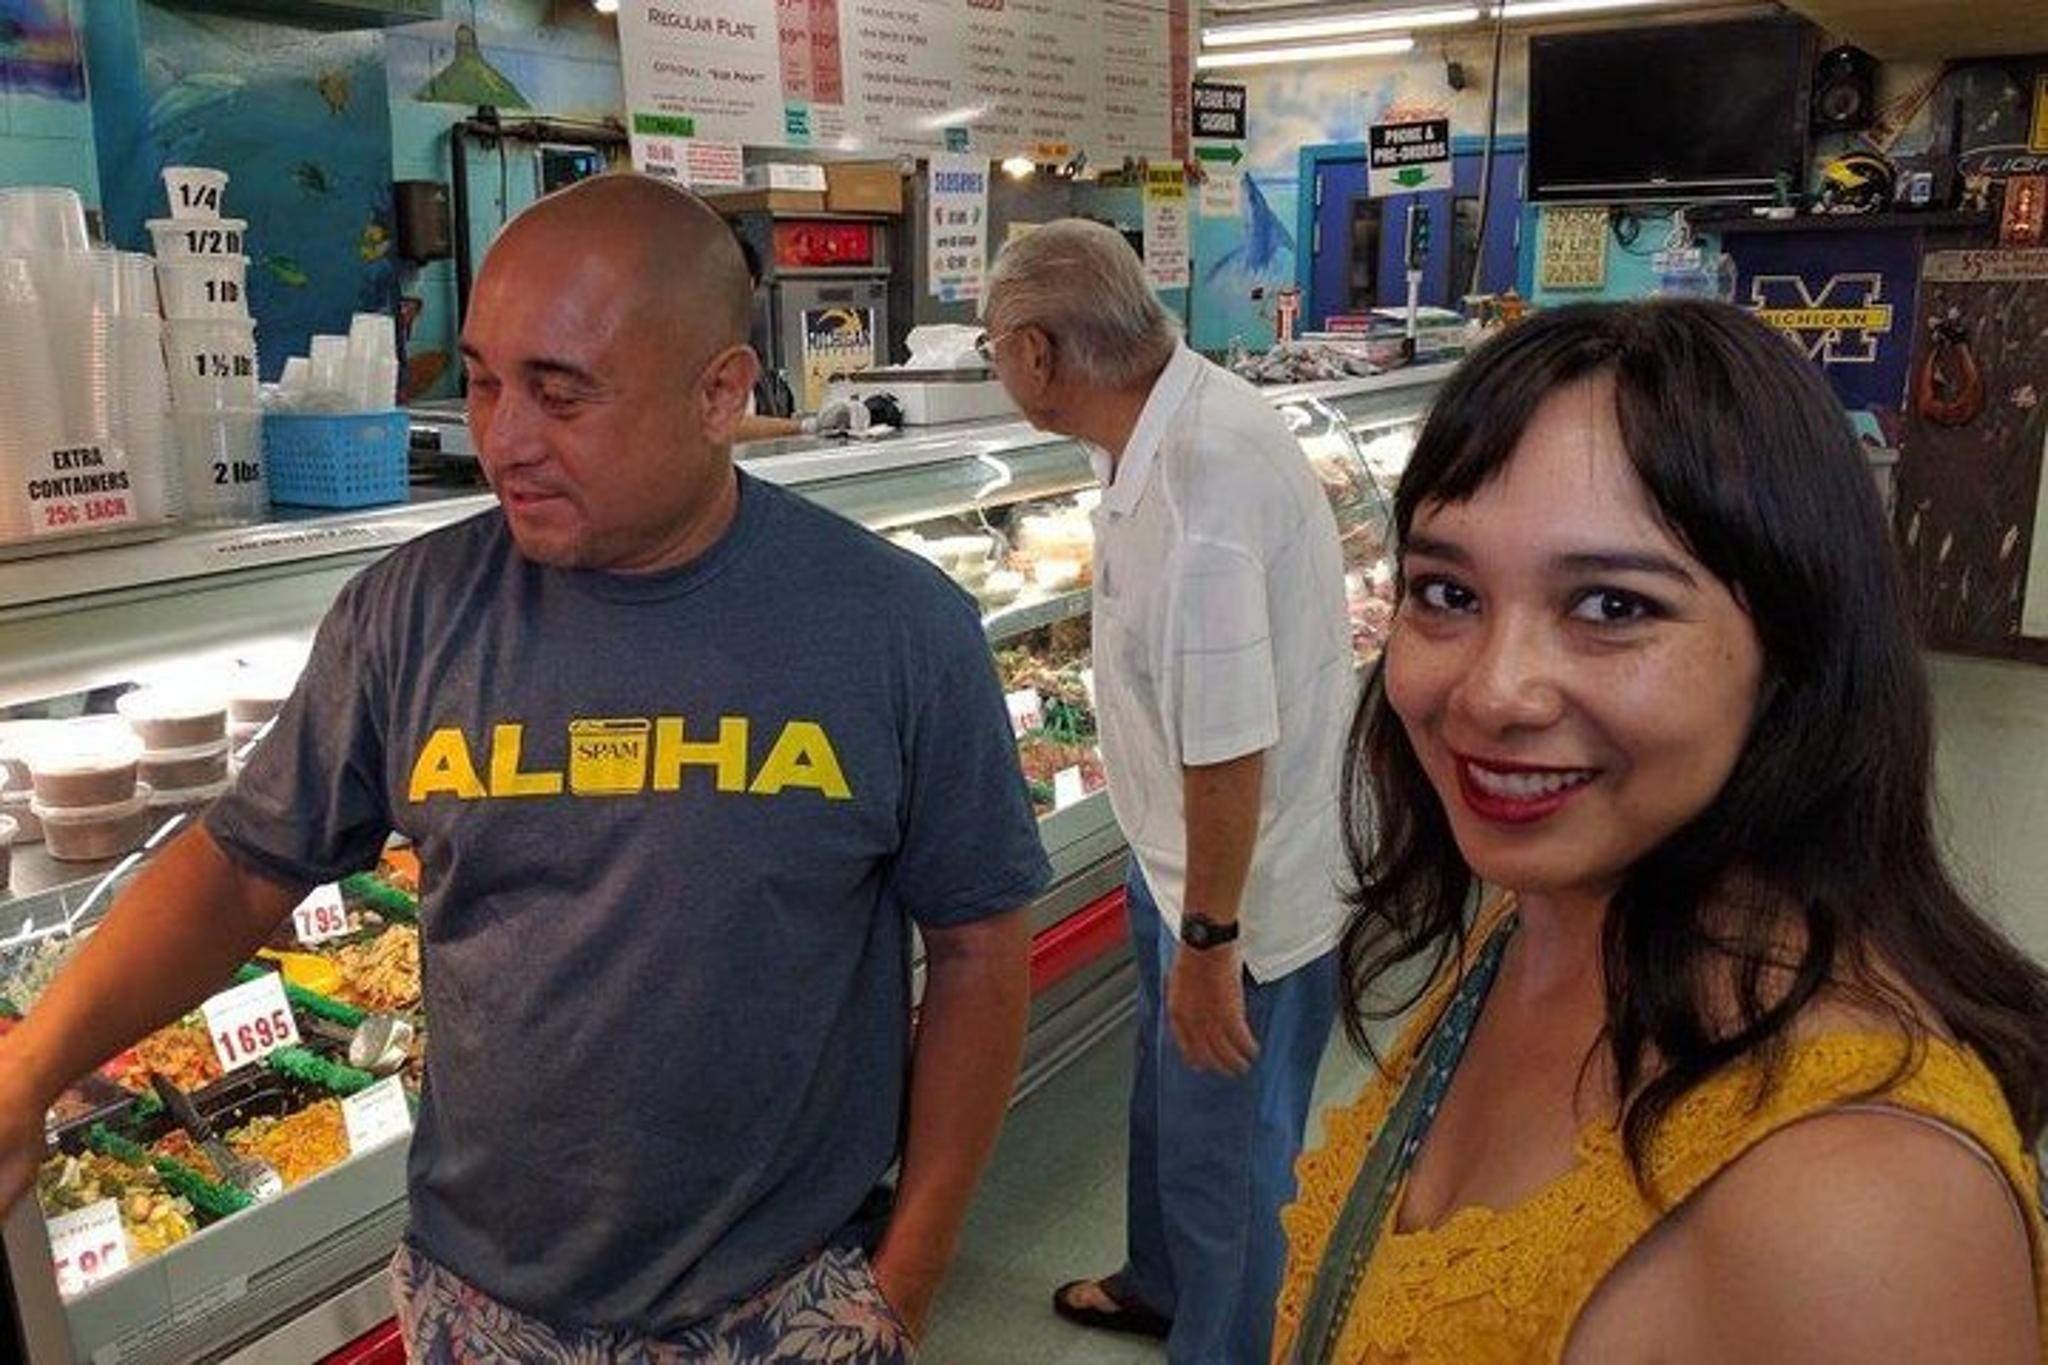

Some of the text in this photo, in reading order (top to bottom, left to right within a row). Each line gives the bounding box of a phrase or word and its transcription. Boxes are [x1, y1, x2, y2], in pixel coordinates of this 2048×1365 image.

[1384, 127, 1422, 145] PHONE
[1373, 142, 1446, 164] PRE-ORDERS
[180, 183, 218, 211] 1/4
[185, 230, 222, 254] 1/2
[205, 280, 215, 303] 1
[194, 353, 206, 377] 1
[53, 445, 104, 470] EXTRA
[213, 461, 229, 485] 2
[28, 470, 129, 501] CONTAINERS
[85, 498, 127, 521] EACH
[578, 738, 639, 763] SPAM
[219, 1009, 290, 1062] 1695
